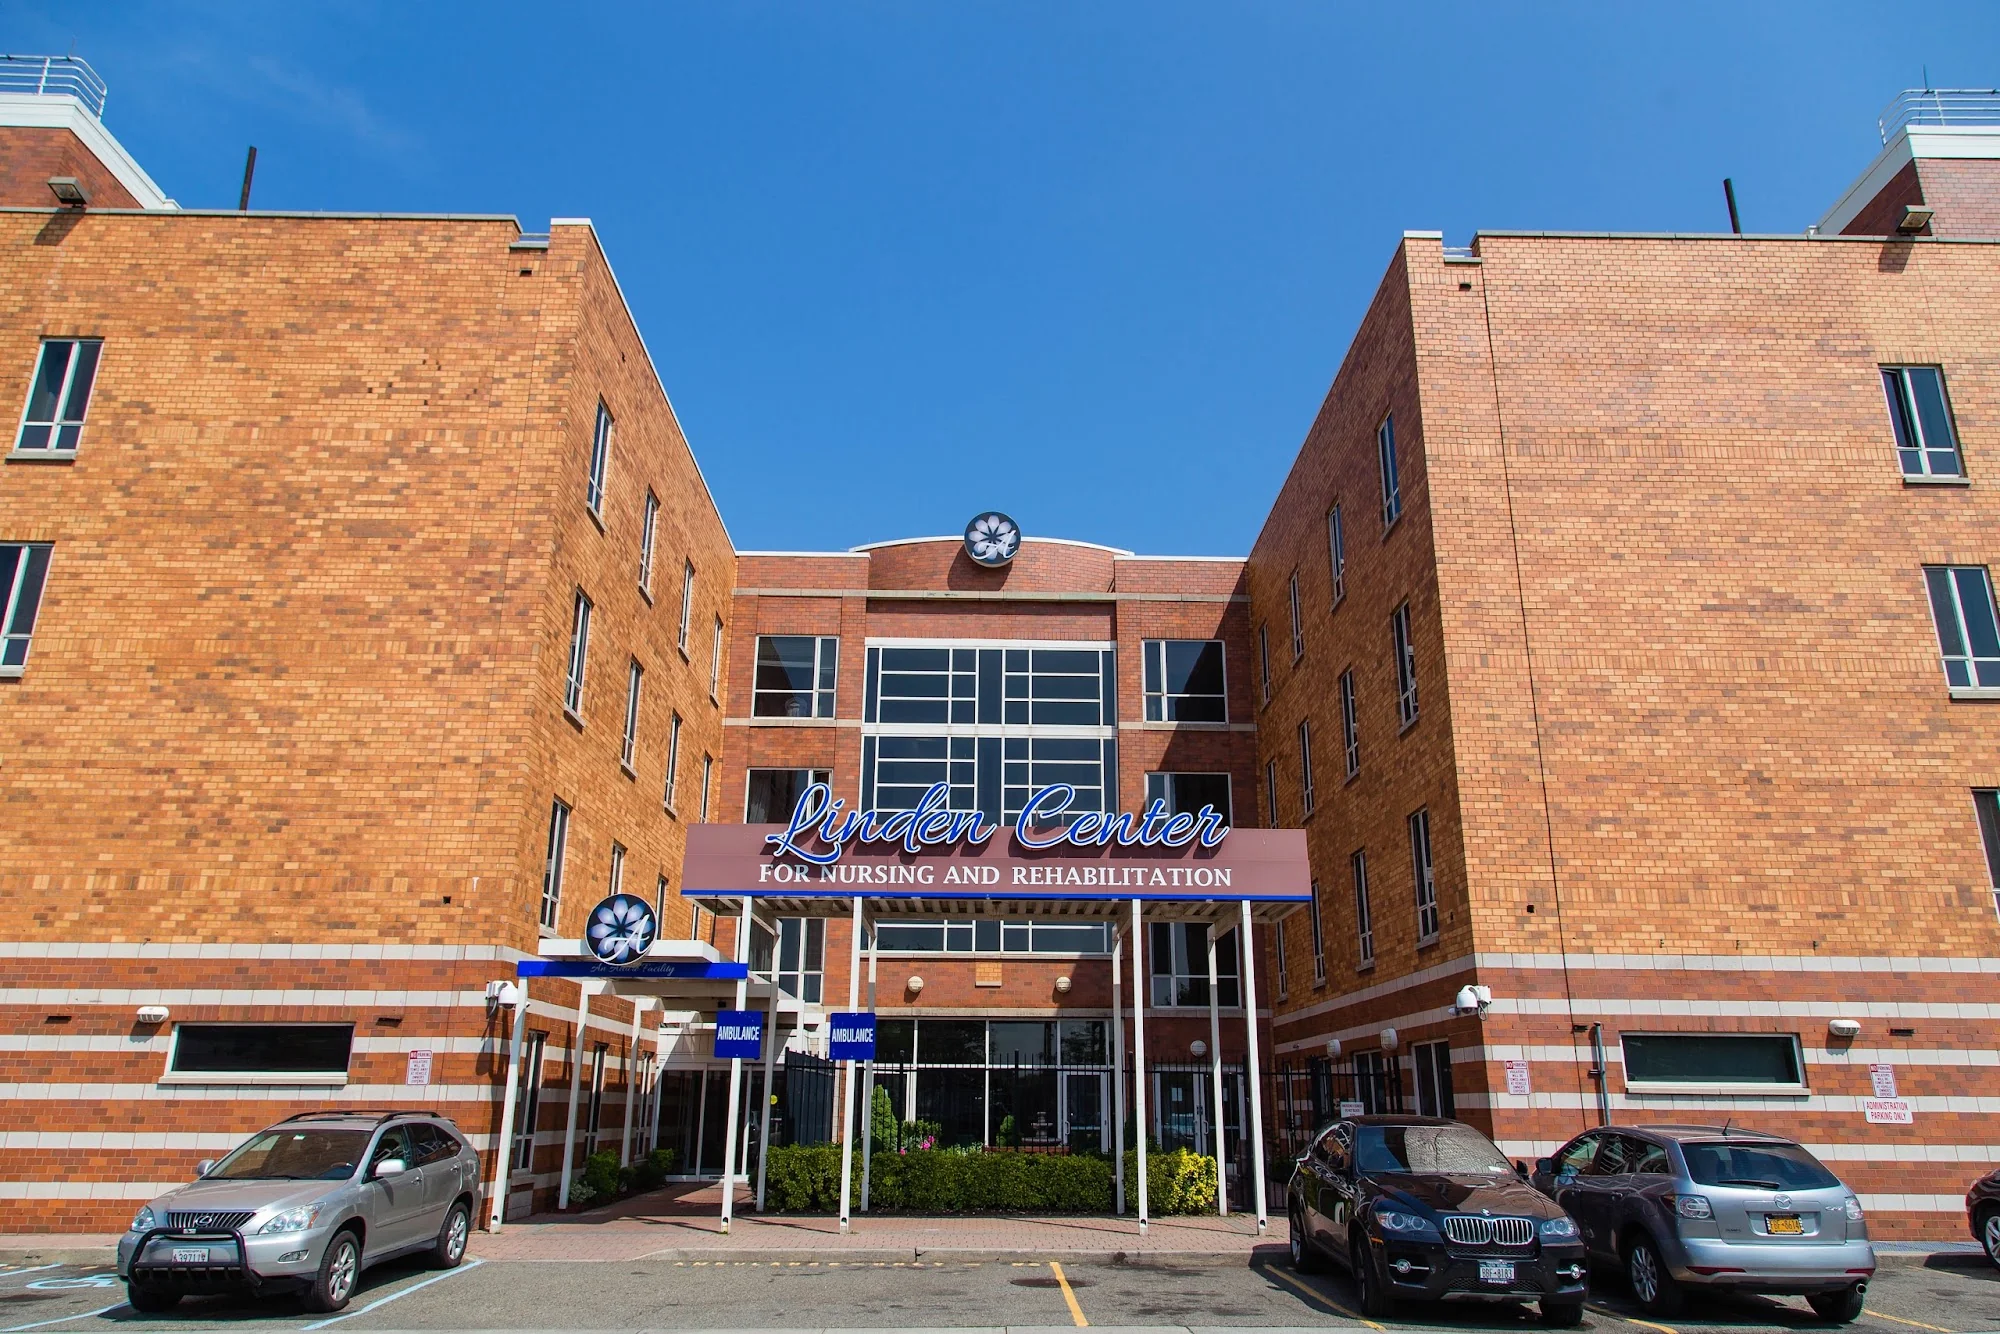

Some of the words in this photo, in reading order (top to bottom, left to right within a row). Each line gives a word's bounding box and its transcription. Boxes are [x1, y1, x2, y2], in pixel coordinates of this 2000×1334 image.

[766, 782, 997, 864] Linden
[1016, 783, 1229, 849] Center
[758, 864, 810, 883] FOR
[819, 864, 934, 885] NURSING
[943, 865, 1000, 886] AND
[1012, 866, 1232, 887] REHABILITATION
[717, 1026, 760, 1041] AMBULANCE
[831, 1028, 874, 1043] AMBULANCE
[1866, 1101, 1908, 1111] ADMINISTRATION
[1871, 1112, 1893, 1120] PARKING
[1894, 1112, 1906, 1120] ONLY
